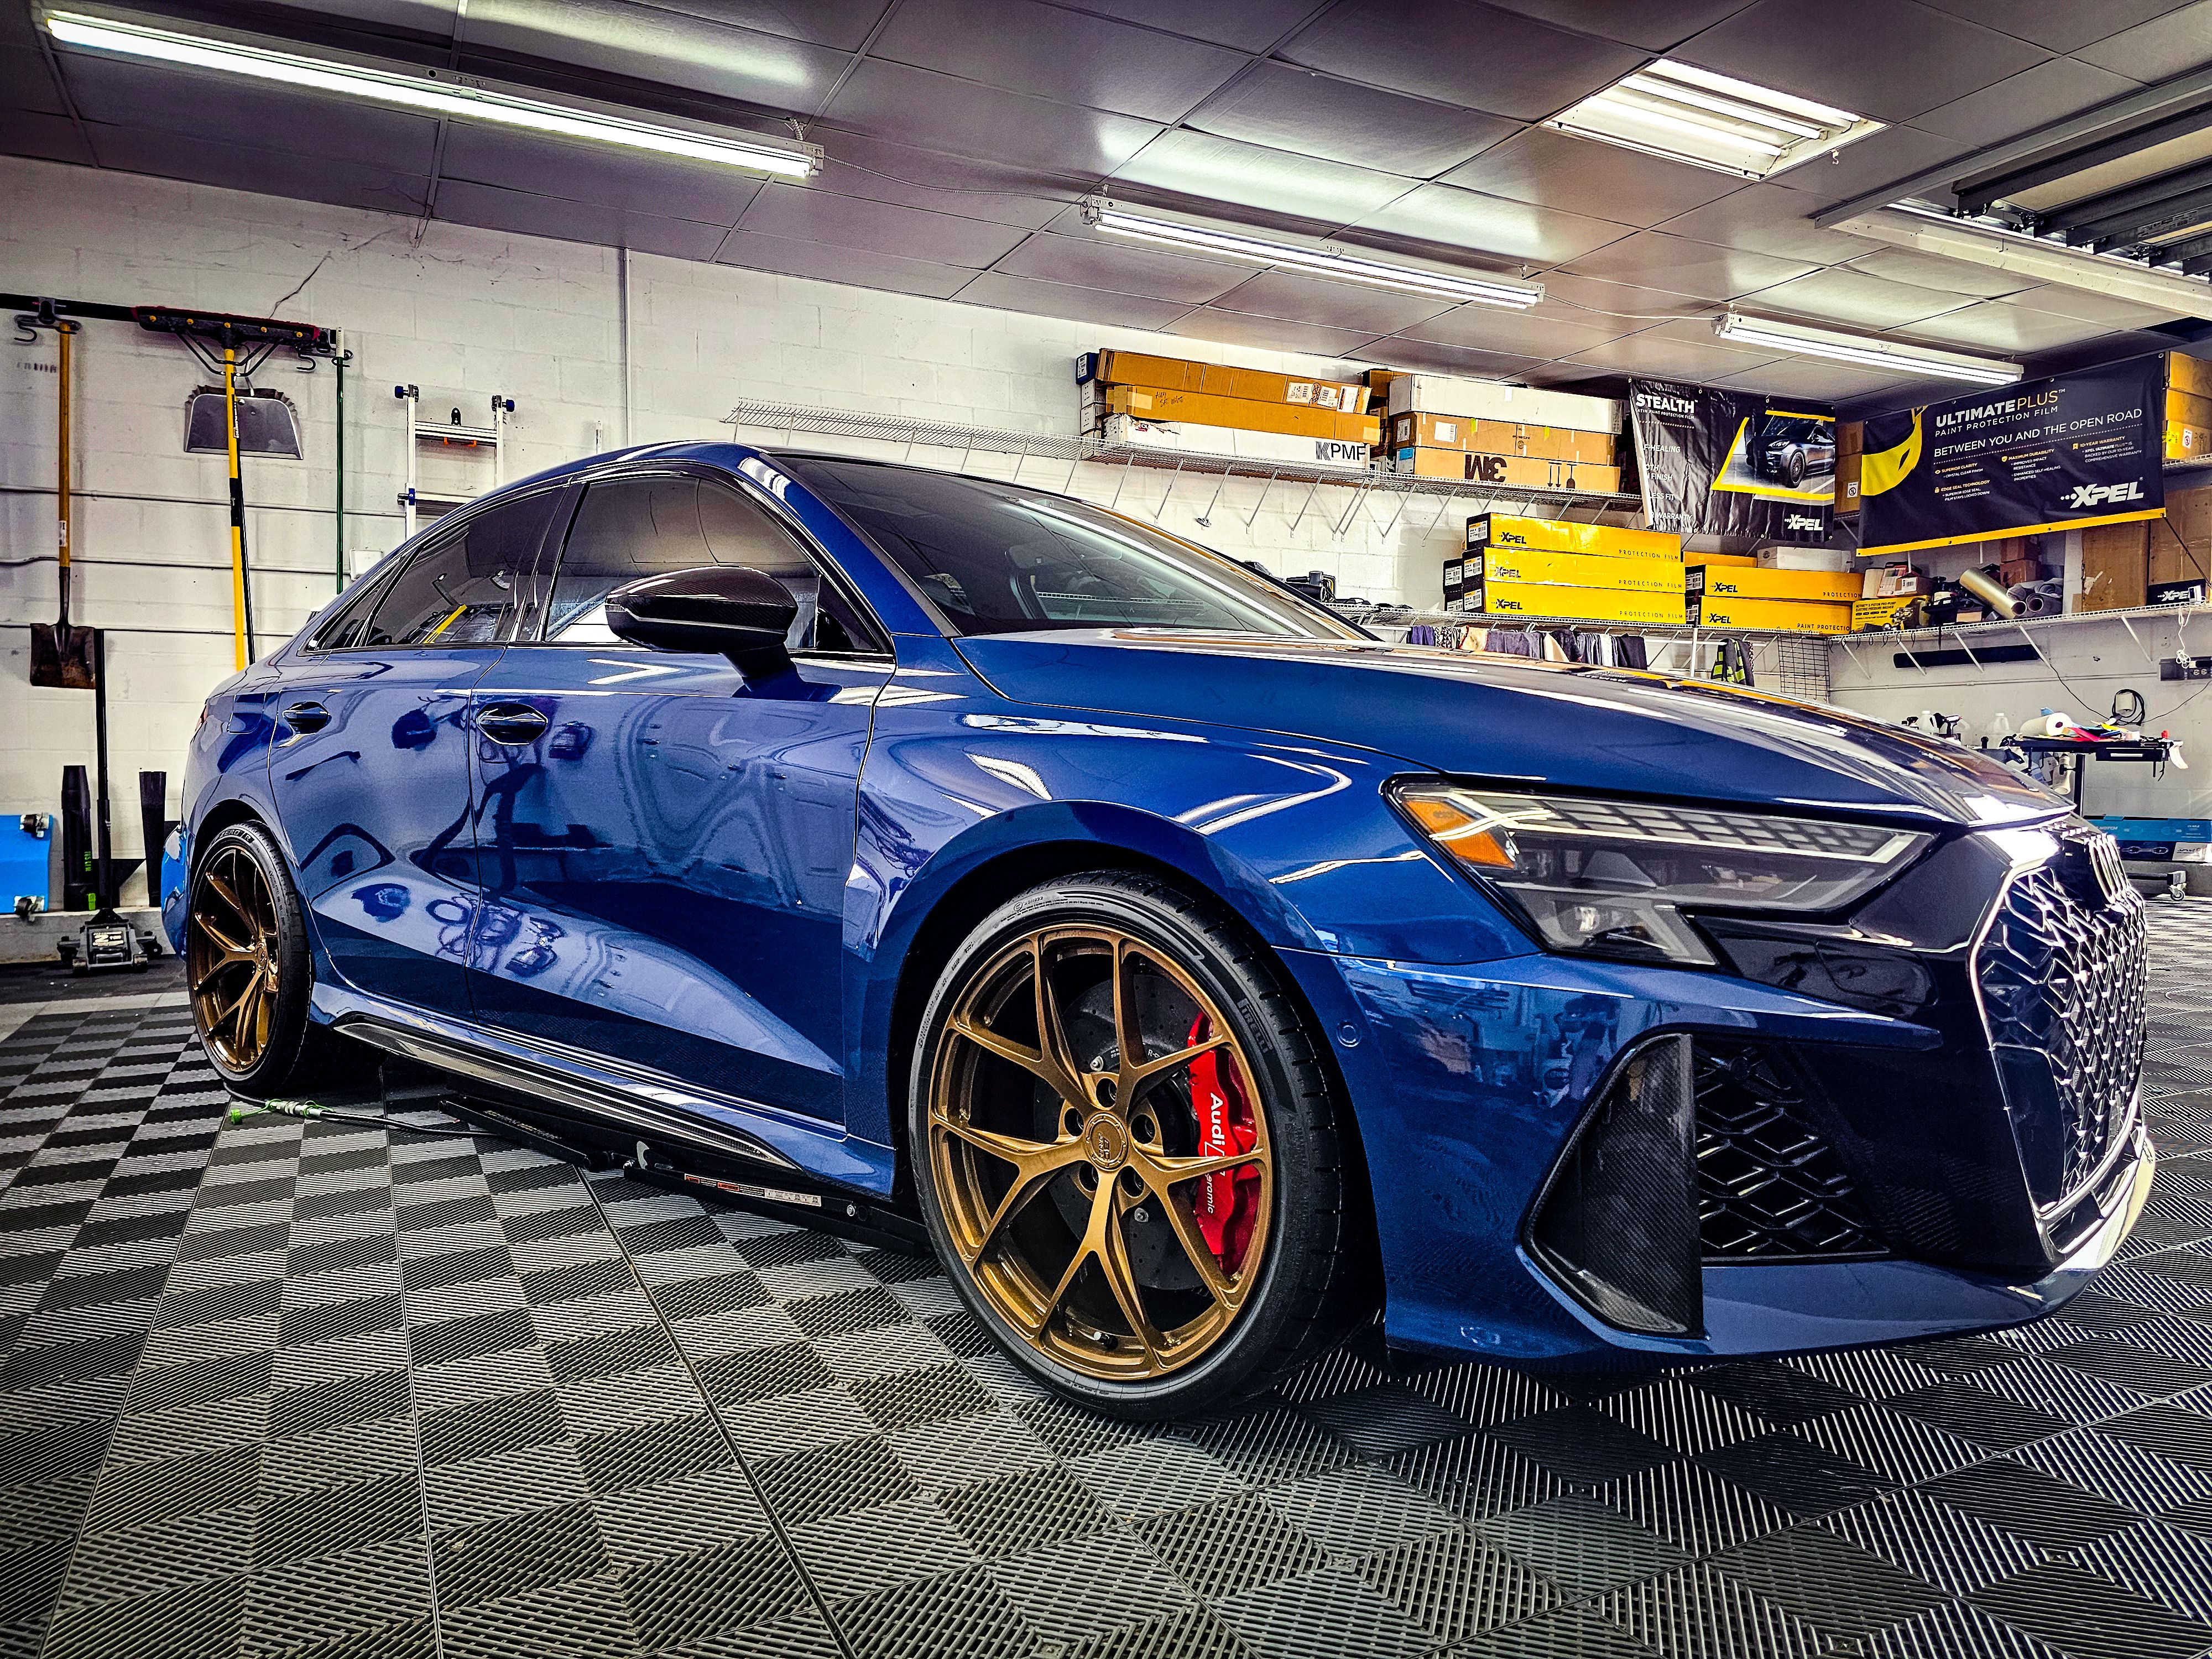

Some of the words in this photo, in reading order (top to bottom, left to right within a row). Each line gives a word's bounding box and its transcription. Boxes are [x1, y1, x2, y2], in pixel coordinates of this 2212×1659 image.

[1936, 426, 1962, 437] PAINT
[1966, 411, 2030, 431] PROTECTION
[2034, 406, 2058, 418] FILM
[1934, 439, 1986, 457] BETWEEN
[1989, 433, 2012, 447] YOU
[2015, 429, 2041, 442] AND
[2043, 422, 2067, 436] THE
[2070, 416, 2104, 431] OPEN
[2107, 408, 2142, 424] ROAD
[2099, 436, 2125, 444] WARRANTY
[1316, 441, 1366, 461] KPMF
[2030, 448, 2055, 457] DURABILITY
[2085, 454, 2117, 463] COMPREHENSIVE
[1464, 454, 1507, 483] 3M
[2034, 465, 2061, 474] SELF-HEALING
[1963, 479, 1990, 488] TECHNOLOGY
[1657, 512, 1693, 521] WARRANTY
[1787, 514, 1824, 531] XPEL
[1501, 532, 1527, 544] XPEL
[1619, 550, 1660, 559] PROTECTION
[1494, 567, 1521, 578] XPEL
[1714, 582, 1738, 593] XPEL
[2161, 590, 2190, 602] XPE
[1495, 599, 1523, 610] XPEL
[1709, 613, 1731, 624] XPEL
[1237, 998, 1274, 1053] PIRELLI
[1210, 1092, 1225, 1145] Audi
